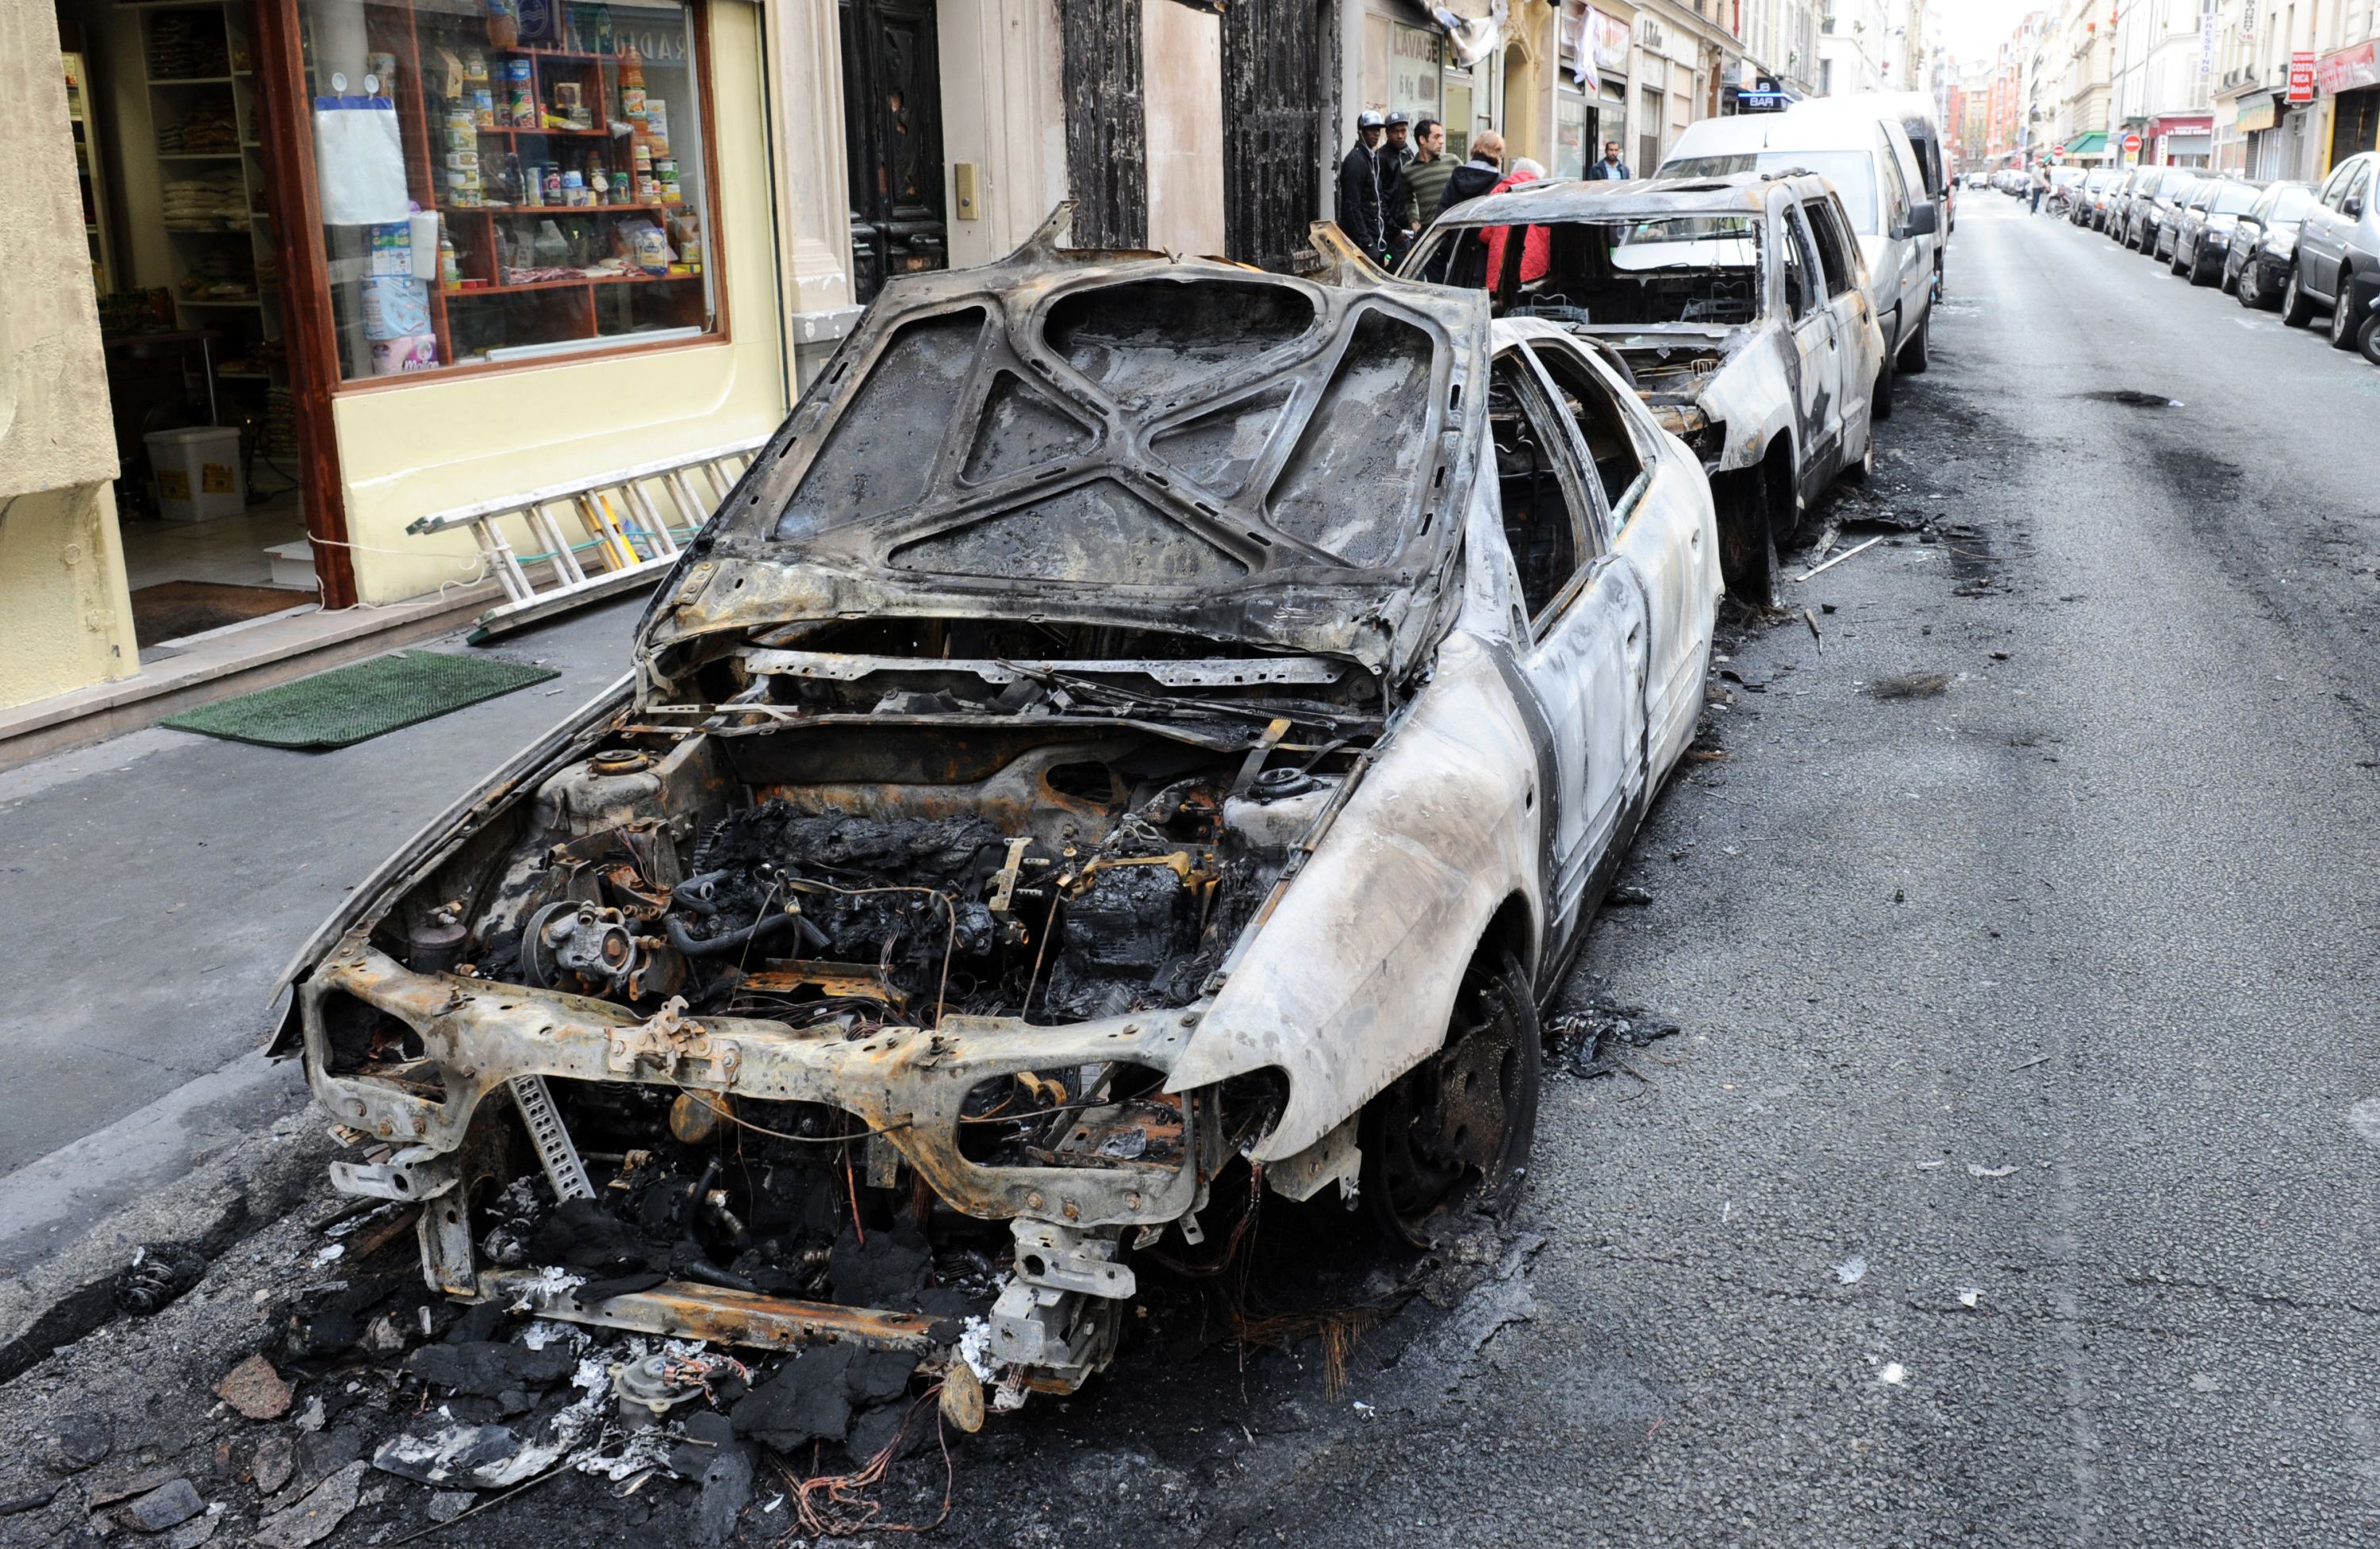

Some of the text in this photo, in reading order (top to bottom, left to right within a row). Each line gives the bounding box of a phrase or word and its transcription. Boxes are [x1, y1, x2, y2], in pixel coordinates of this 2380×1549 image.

[1394, 30, 1438, 63] LAVAGE
[2202, 16, 2213, 73] PRESSING
[2292, 63, 2313, 72] COSTA
[2292, 74, 2309, 83] RICA
[2290, 85, 2311, 94] Beach
[1750, 98, 1773, 106] BAR
